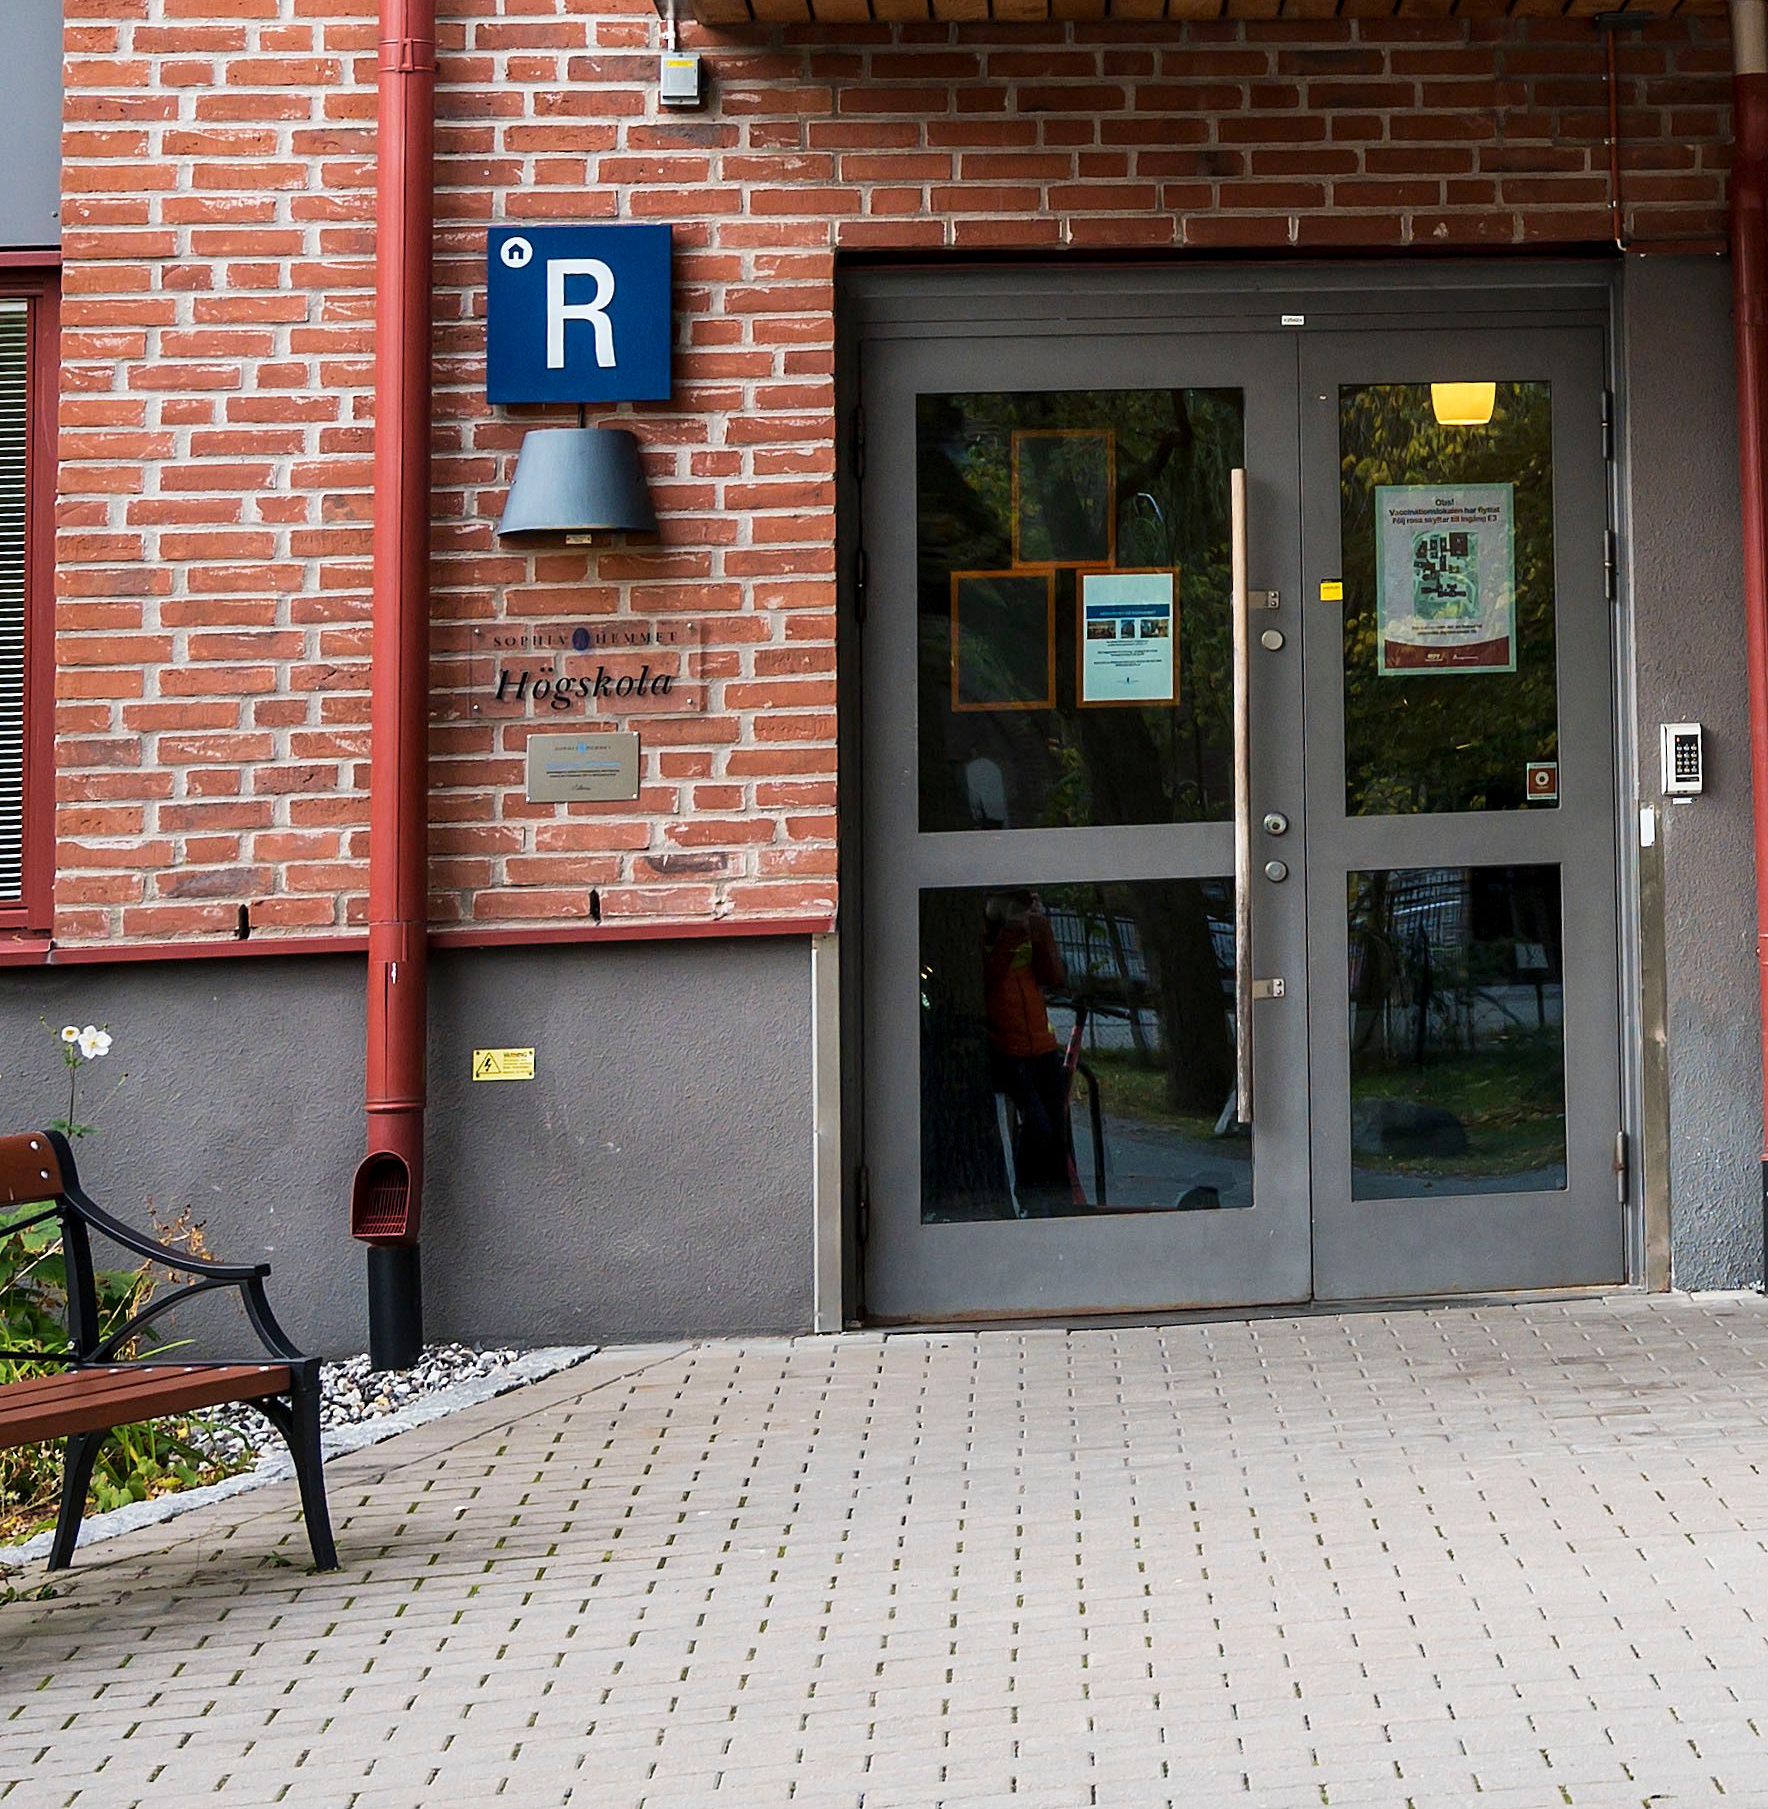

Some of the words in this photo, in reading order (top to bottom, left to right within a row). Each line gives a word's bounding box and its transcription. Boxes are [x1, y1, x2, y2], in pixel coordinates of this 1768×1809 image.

[545, 257, 617, 370] R
[493, 635, 569, 648] SOPHIA
[594, 630, 679, 646] HEMMET
[494, 665, 674, 711] Högskola
